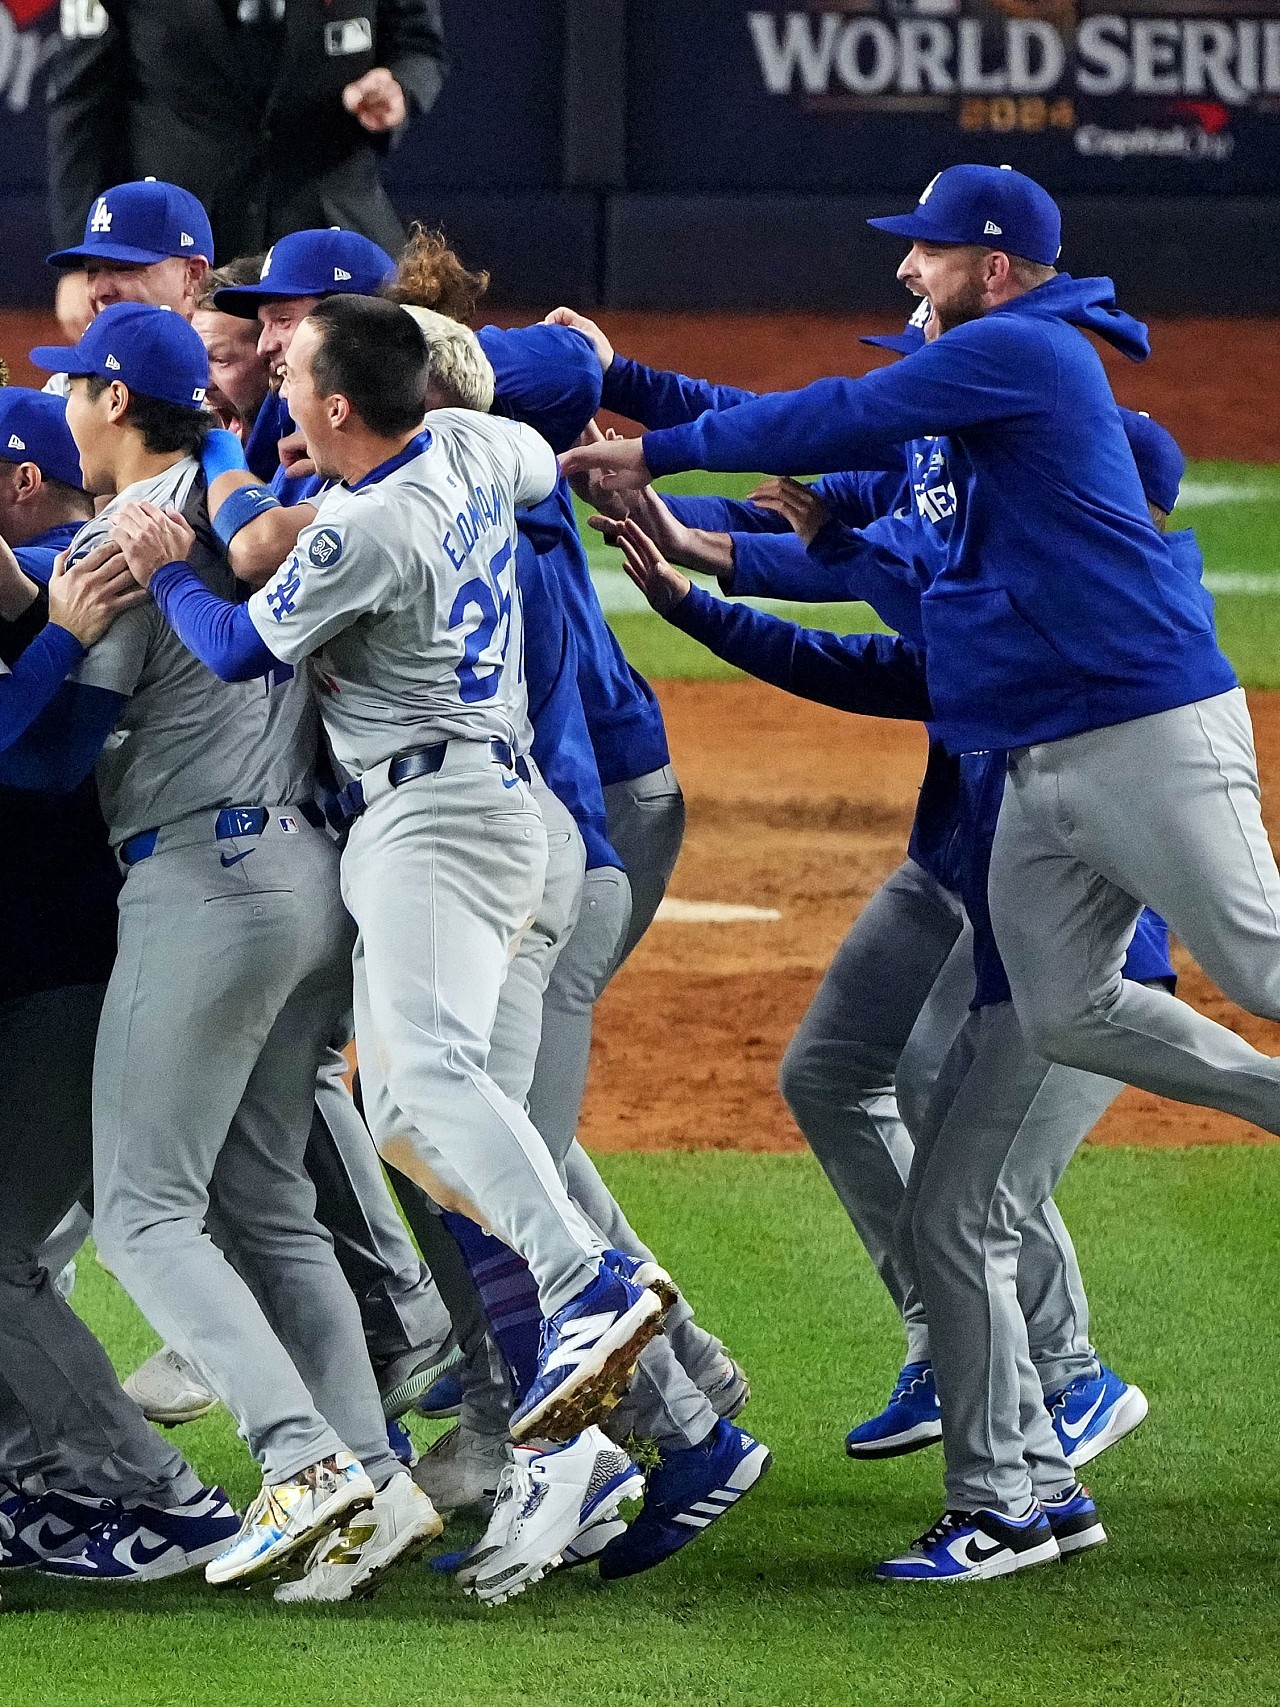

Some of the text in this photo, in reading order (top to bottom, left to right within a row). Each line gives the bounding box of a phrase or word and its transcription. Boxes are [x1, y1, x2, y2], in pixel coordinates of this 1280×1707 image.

[748, 12, 1066, 95] WORLD
[90, 196, 113, 232] LA
[312, 539, 334, 563] 34
[442, 483, 502, 572] EDMAN
[266, 556, 301, 624] LA
